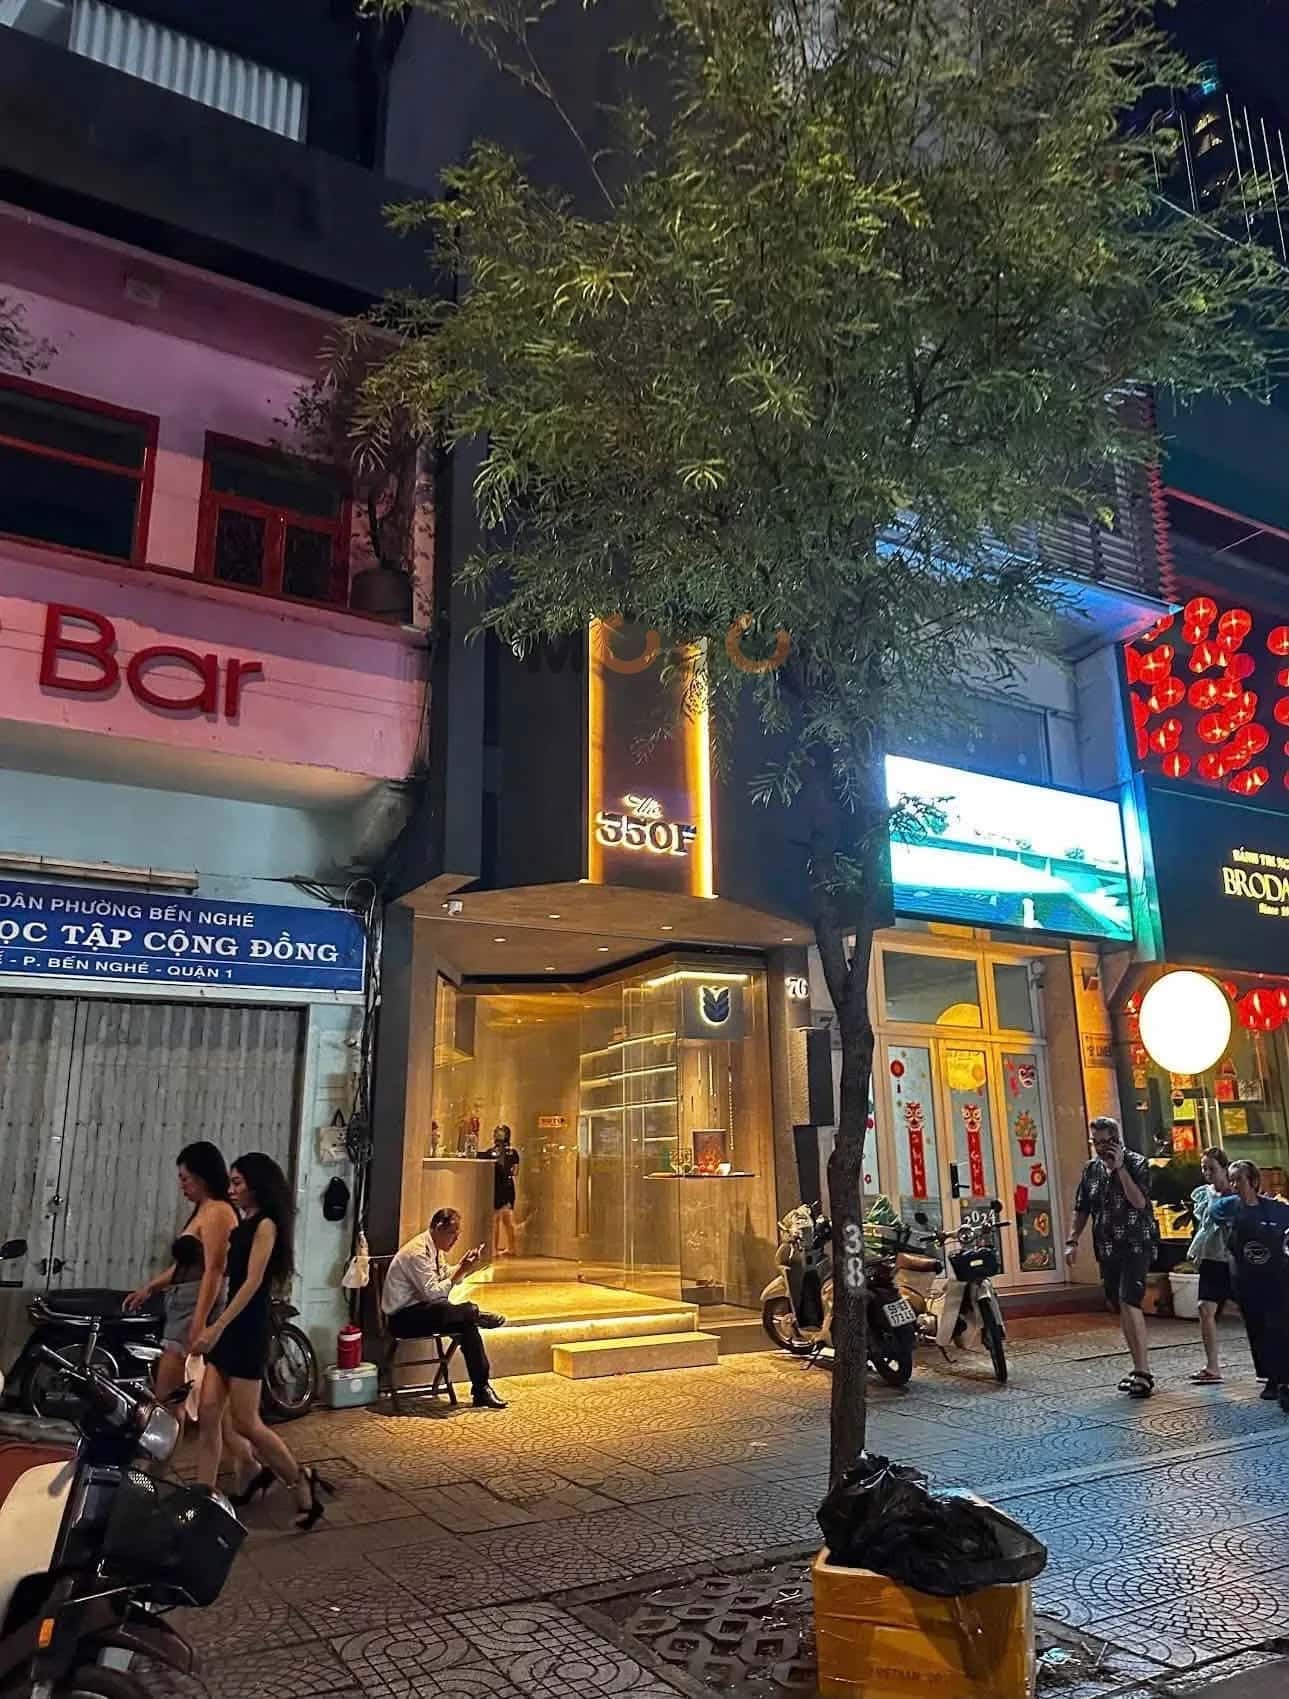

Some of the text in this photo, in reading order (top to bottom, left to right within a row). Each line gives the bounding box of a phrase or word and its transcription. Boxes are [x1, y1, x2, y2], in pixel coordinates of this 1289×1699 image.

[40, 602, 263, 718] Bar
[623, 793, 664, 820] The
[51, 898, 142, 919] PHƯỜNG
[149, 904, 192, 923] BẾN
[199, 911, 255, 928] NGHÉ
[61, 922, 133, 951] TẬP
[143, 929, 239, 957] CỘNG
[249, 931, 339, 963] ĐỒNG
[23, 956, 41, 967] P.
[48, 955, 89, 970] BẾN
[95, 961, 149, 974] NGHÉ
[167, 965, 219, 979] QUẬN
[225, 969, 233, 979] 1
[784, 976, 809, 999] 76
